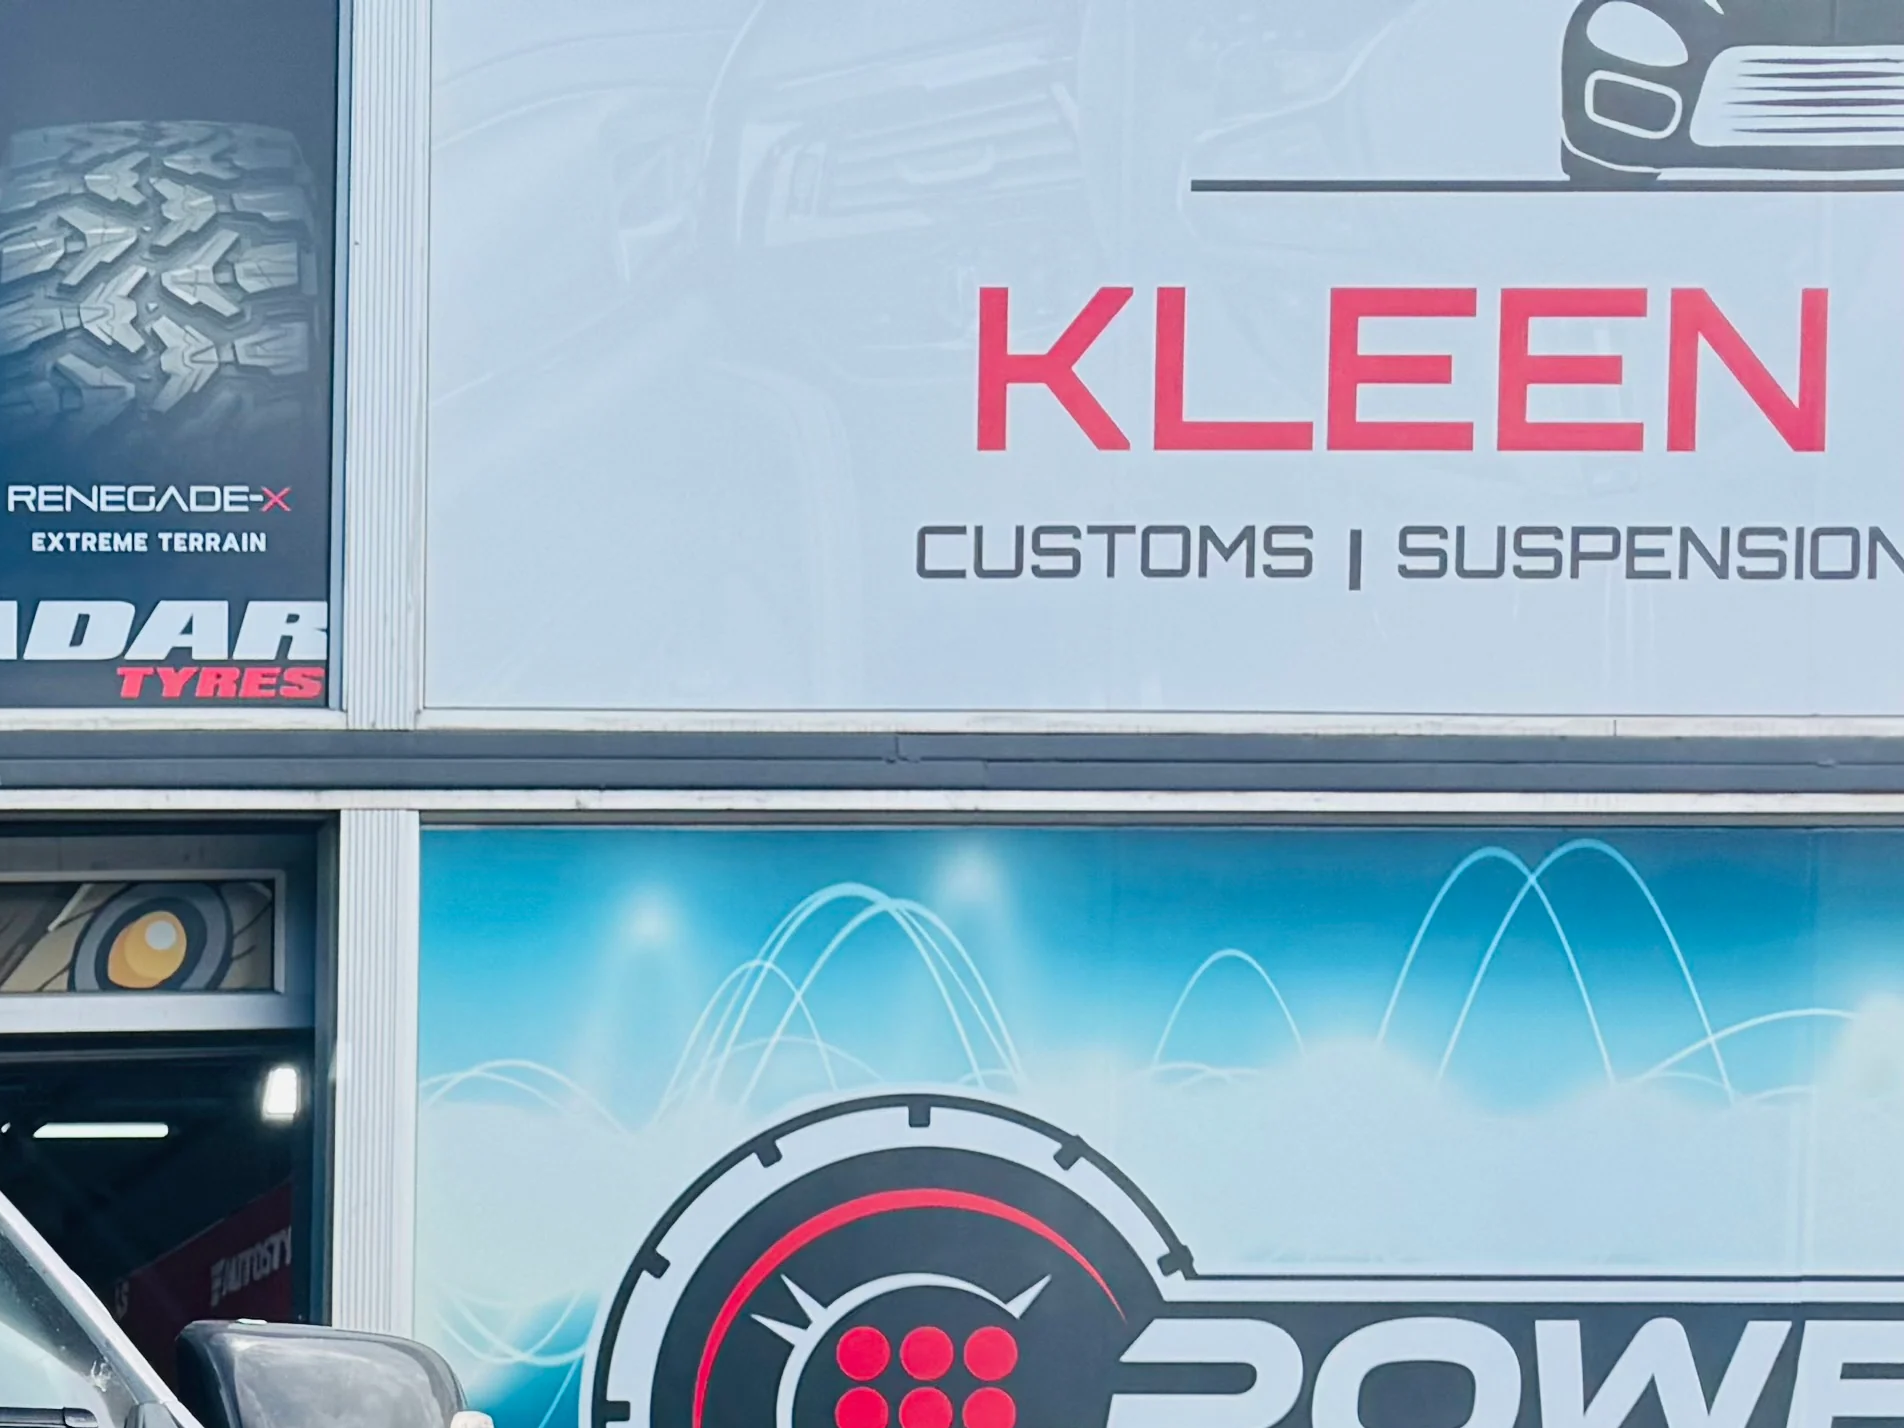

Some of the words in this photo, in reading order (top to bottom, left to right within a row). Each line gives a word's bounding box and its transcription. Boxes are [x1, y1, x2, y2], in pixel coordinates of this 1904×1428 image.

[976, 286, 1829, 453] KLEEN
[7, 485, 292, 512] RENEGADE-X
[31, 531, 149, 552] EXTREME
[157, 532, 267, 553] TERRAIN
[916, 524, 1314, 580] CUSTOMS
[1397, 525, 1904, 581] SUSPENSION
[117, 666, 326, 699] TYRES
